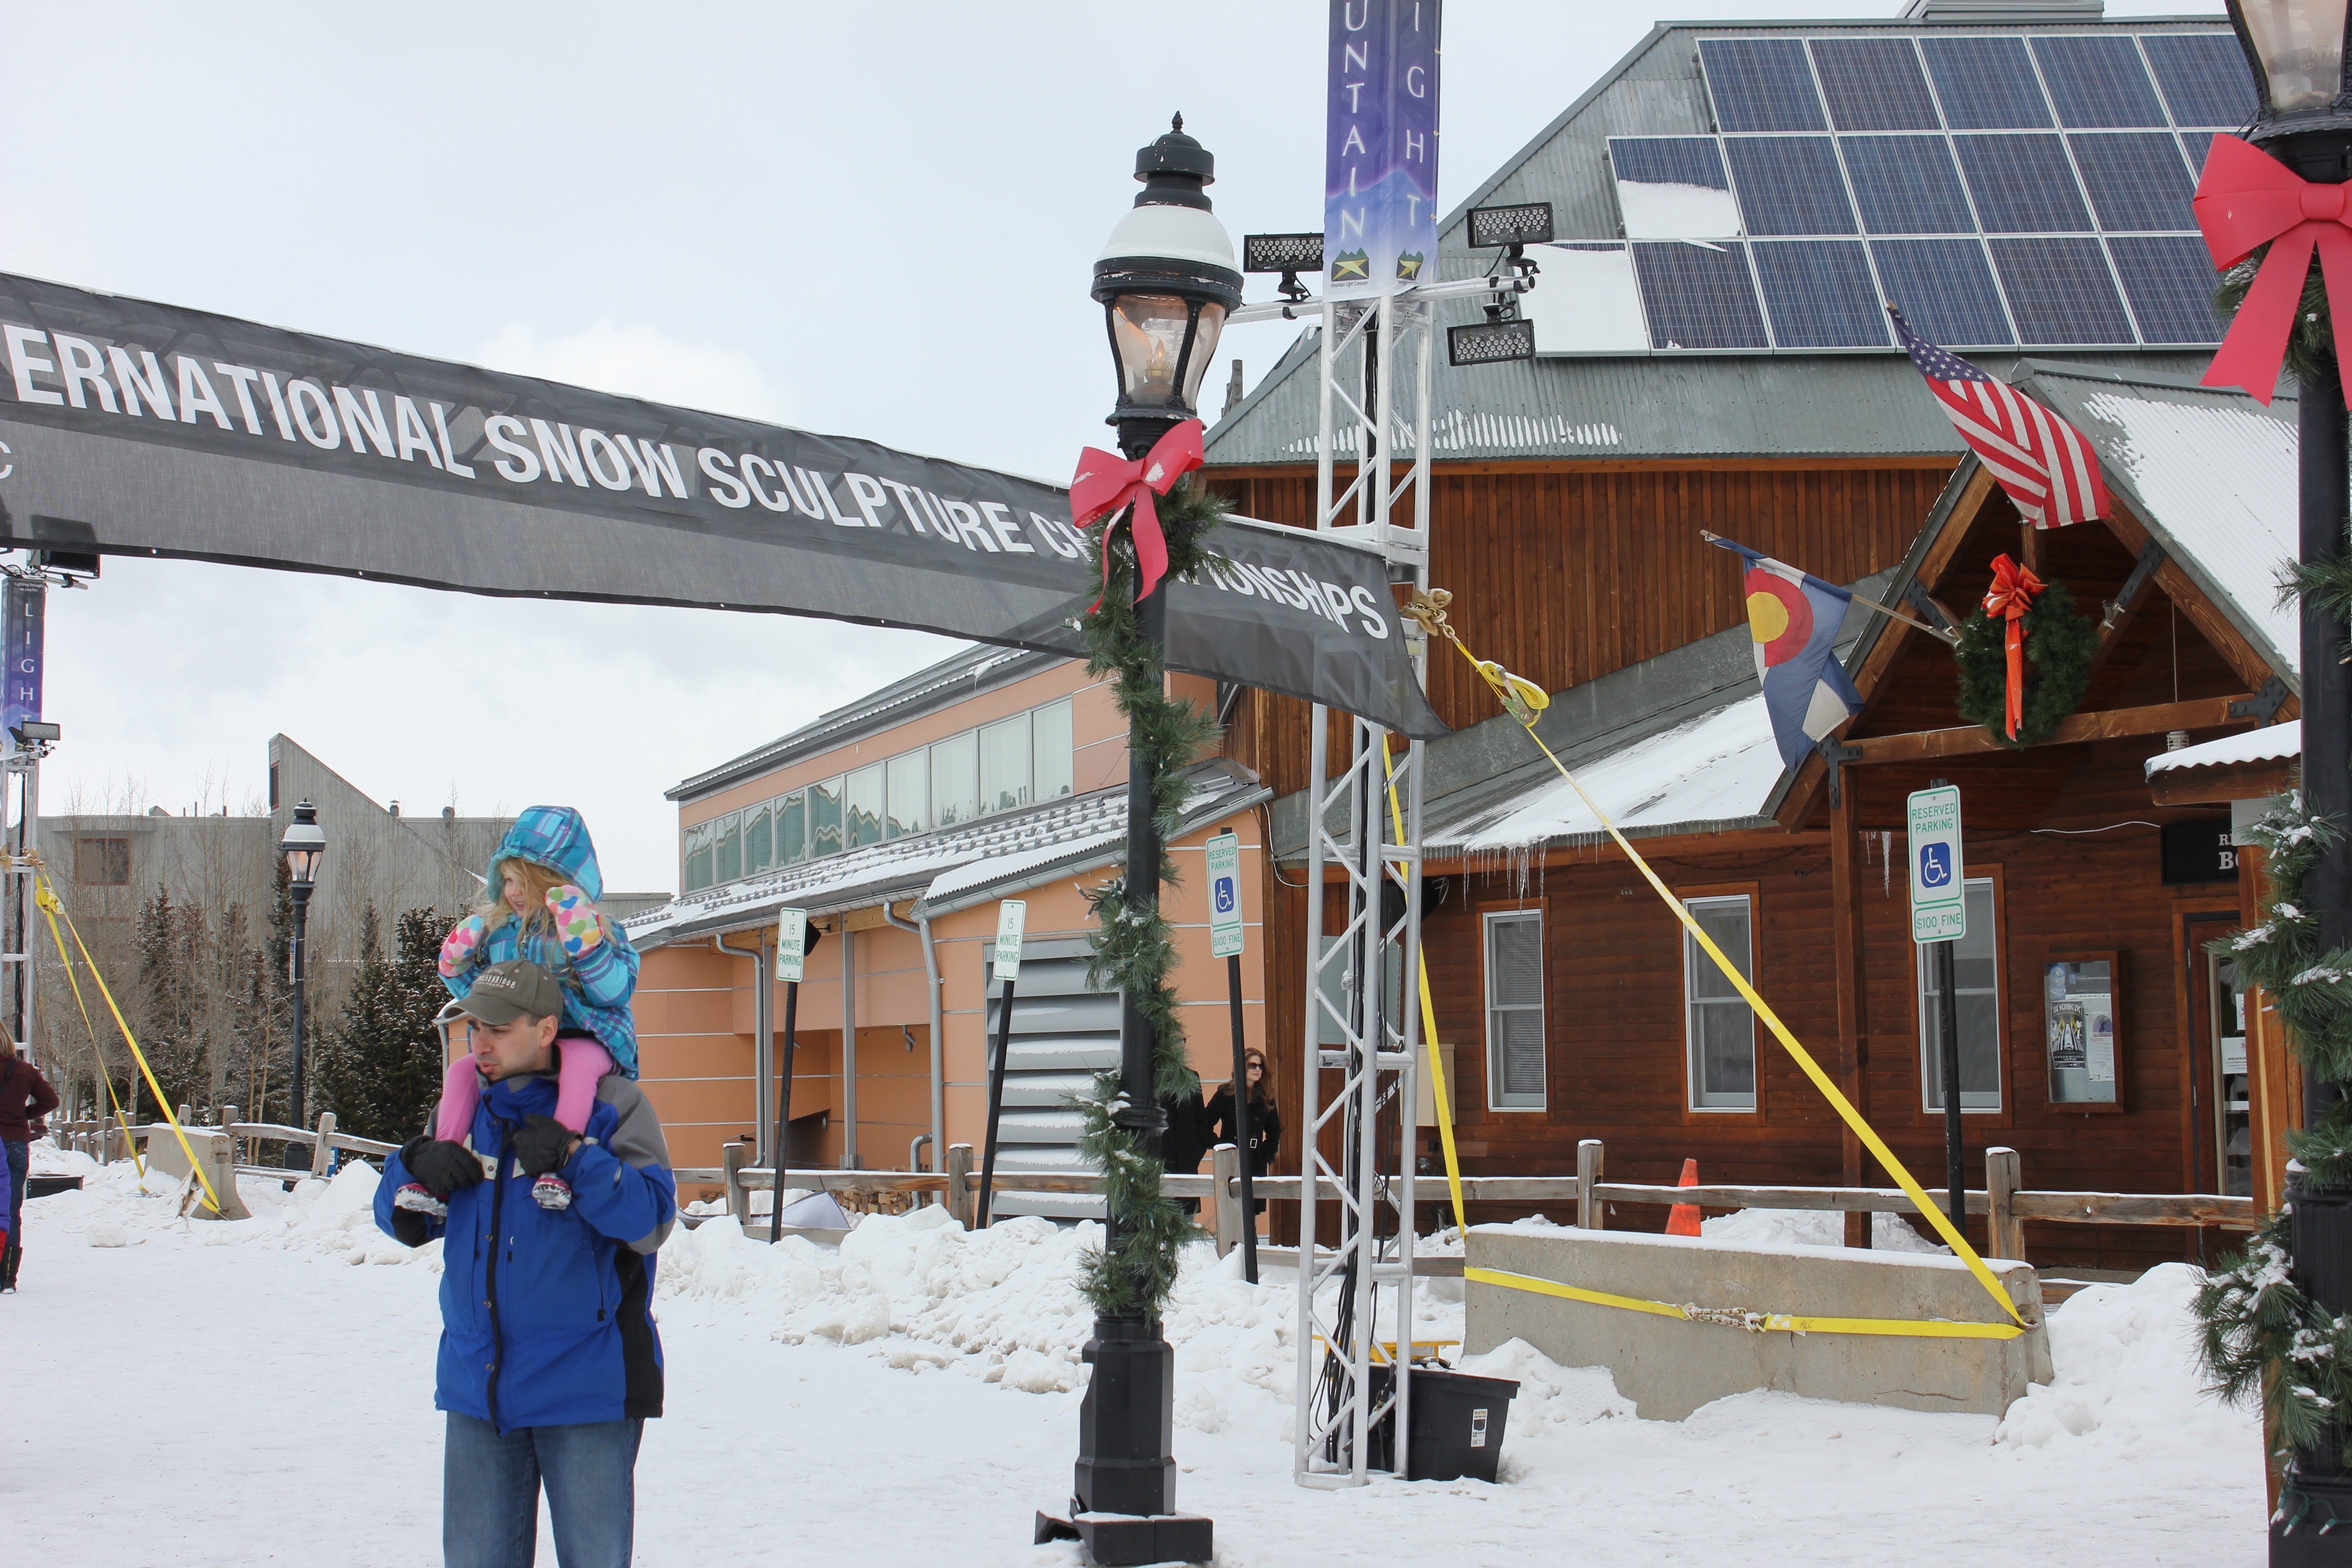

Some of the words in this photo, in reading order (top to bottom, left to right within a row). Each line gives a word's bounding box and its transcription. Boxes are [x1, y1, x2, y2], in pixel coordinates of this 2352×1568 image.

[485, 416, 688, 499] SNOW
[698, 448, 1035, 553] SCULPTURE
[1912, 803, 1955, 820] RESERVED
[1916, 818, 1953, 834] PARKING
[1209, 846, 1235, 860] RESERVED
[1211, 858, 1234, 871] PARKING
[1008, 917, 1014, 929] 15
[1916, 916, 1936, 930] $100
[1942, 913, 1961, 926] FINE
[789, 924, 795, 935] 15
[781, 939, 800, 951] MINUTE
[999, 934, 1018, 946] MINUTE
[1214, 936, 1226, 947] $100
[1229, 933, 1241, 944] FINE
[779, 954, 801, 965] PARKING
[996, 951, 1018, 963] PARKING
